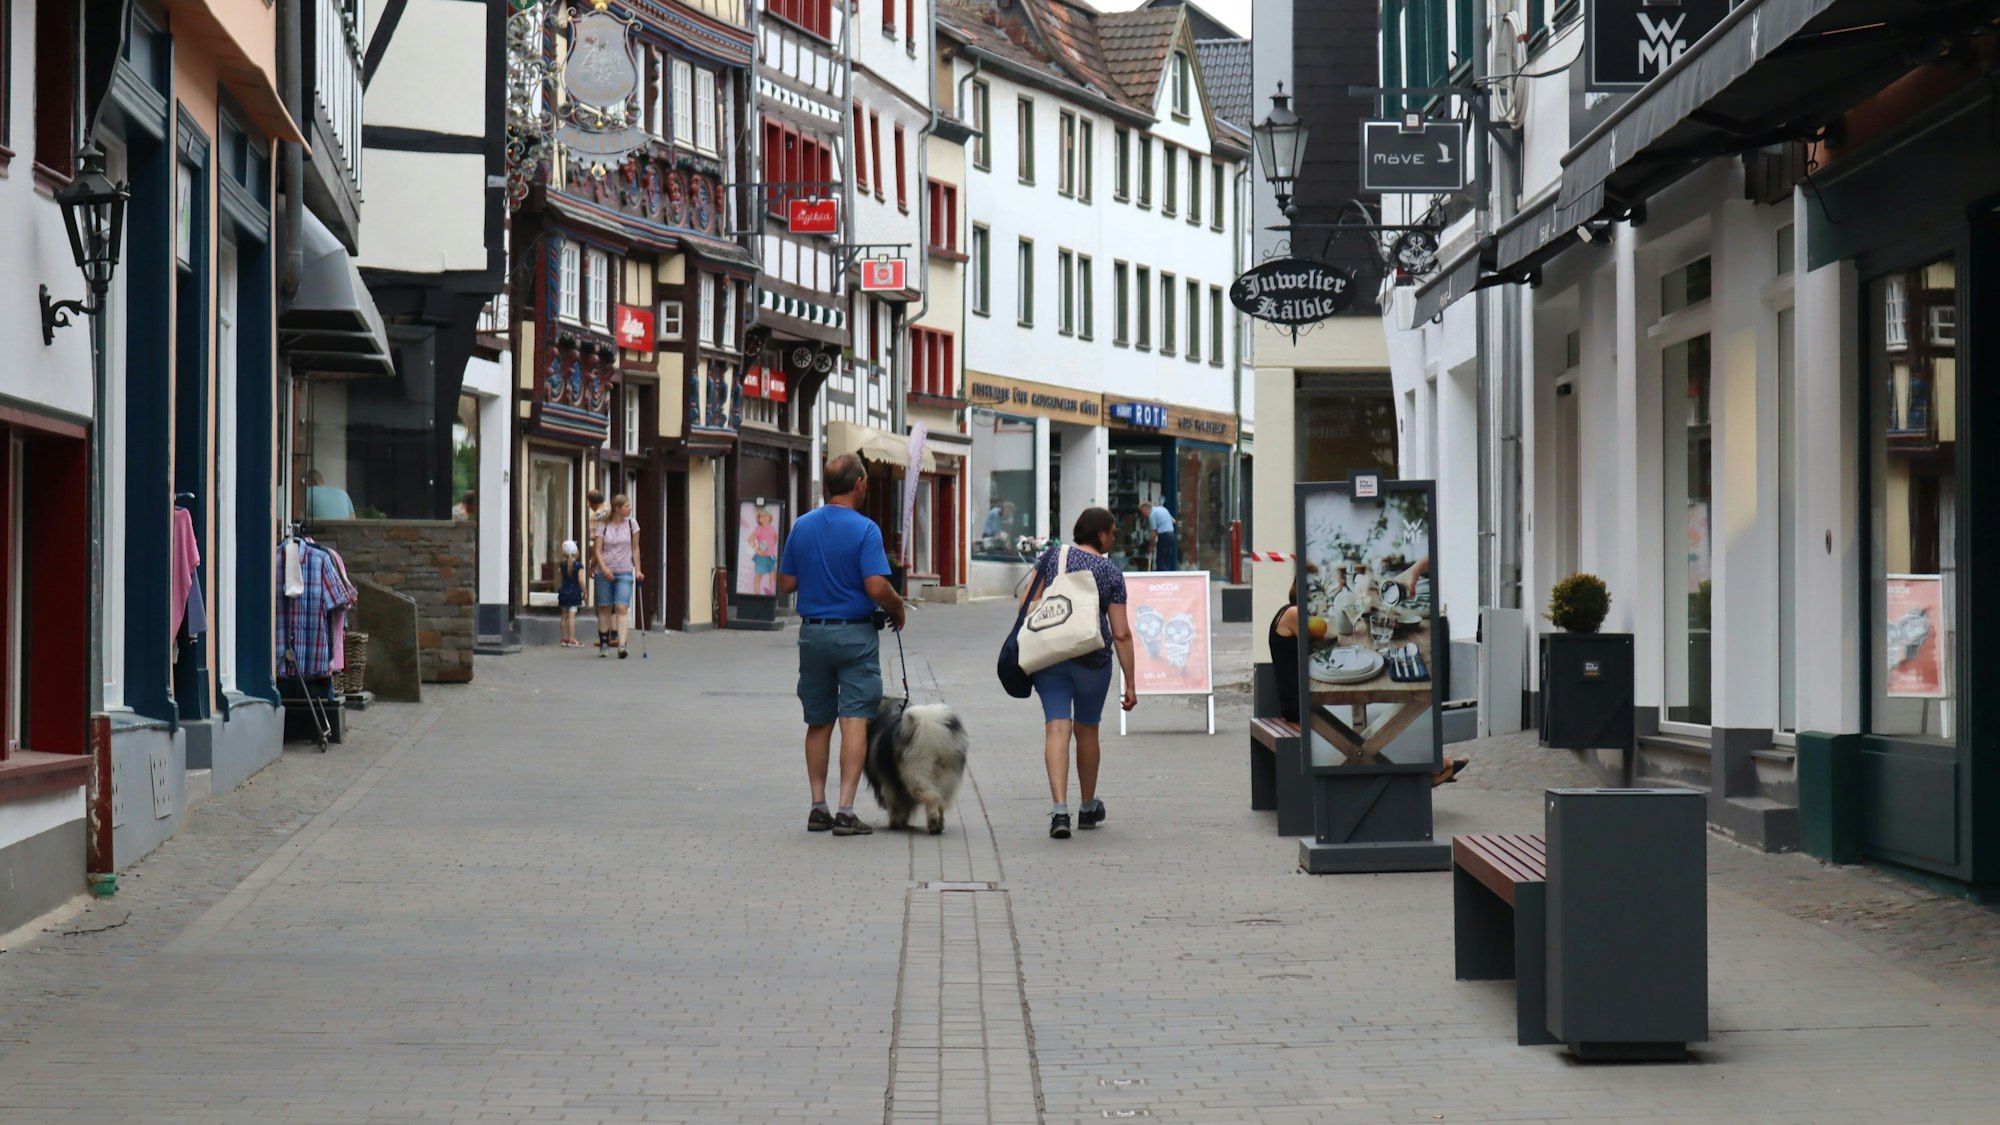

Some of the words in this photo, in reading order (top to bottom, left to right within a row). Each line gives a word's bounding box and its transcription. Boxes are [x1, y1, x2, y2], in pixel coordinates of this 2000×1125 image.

[1240, 268, 1347, 302] Juwelier
[1252, 295, 1335, 320] Kälble
[1135, 404, 1168, 428] ROTH
[1149, 583, 1180, 592] BOCCIA
